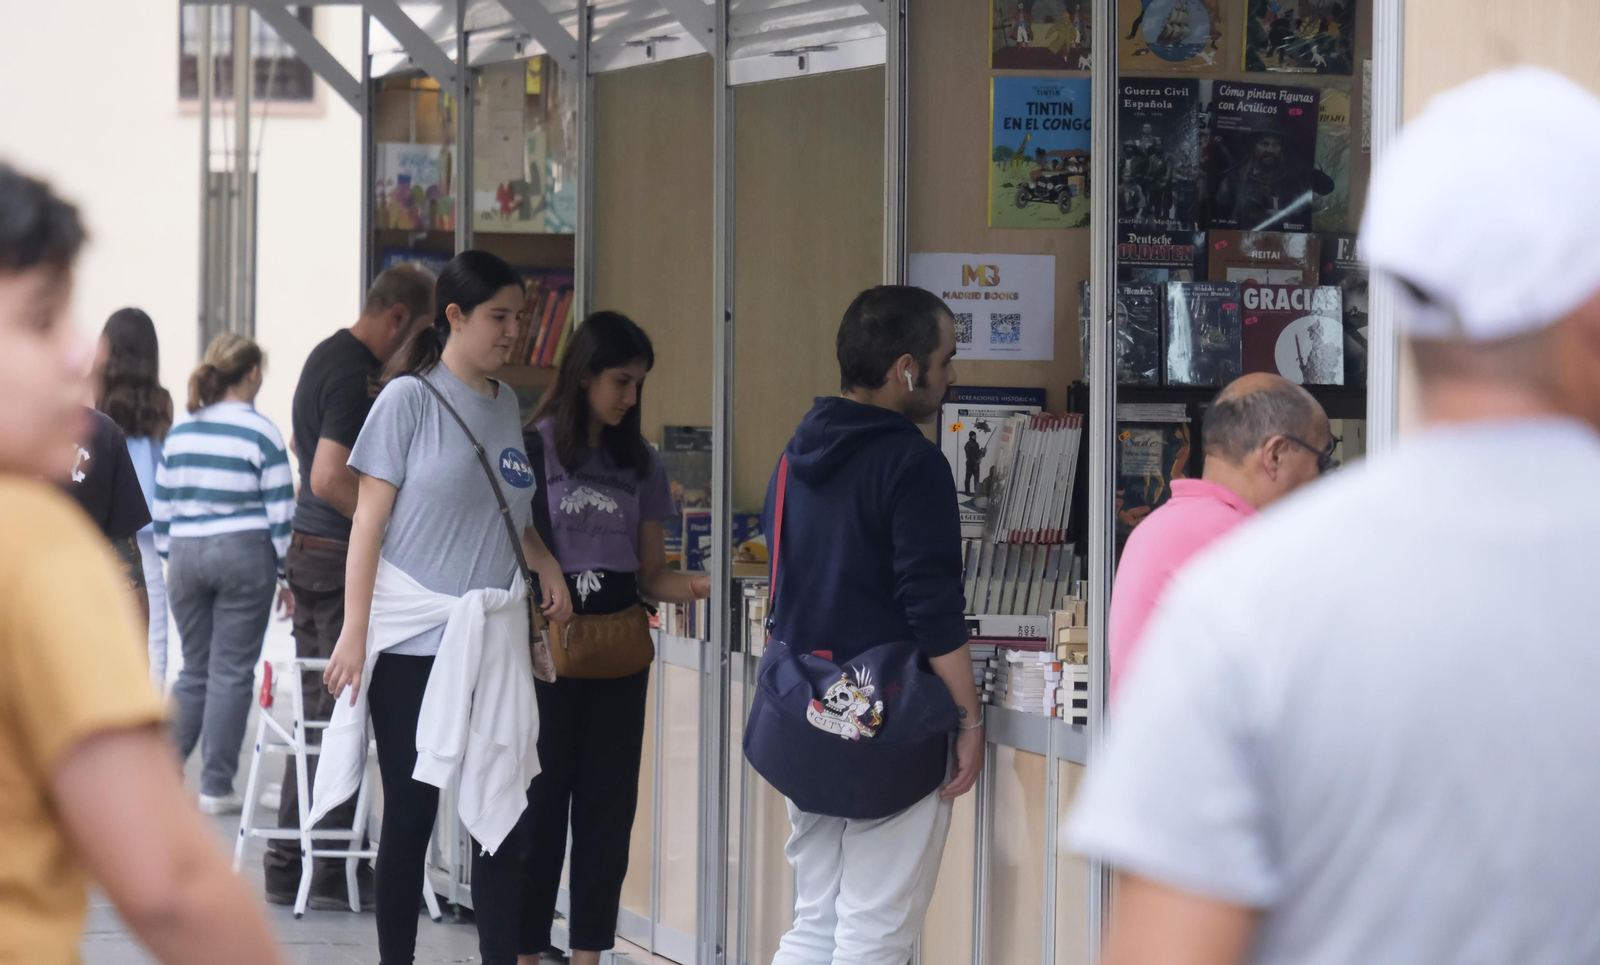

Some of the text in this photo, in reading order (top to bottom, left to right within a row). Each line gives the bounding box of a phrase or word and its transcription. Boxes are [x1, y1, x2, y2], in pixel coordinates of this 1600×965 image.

[1036, 89, 1060, 97] TINTIN
[1124, 86, 1161, 97] Guerra
[1164, 86, 1189, 97] Civil
[1219, 84, 1314, 104] Cómo pintar Figuras
[1025, 101, 1074, 116] TINTIN
[1123, 98, 1173, 111] Española
[1218, 101, 1235, 112] con
[1236, 100, 1278, 115] Acrílicos
[1003, 117, 1092, 132] EN EL CONGO
[1127, 232, 1172, 245] Deutsche
[1117, 243, 1194, 261] OLDATEN
[1251, 249, 1281, 260] HEITAI
[942, 291, 1020, 301] MADRID BOOKS
[1000, 395, 1037, 403] HISTÓRICAS
[1125, 436, 1160, 448] Sade
[502, 458, 533, 477] NASA
[814, 716, 845, 733] CITY
